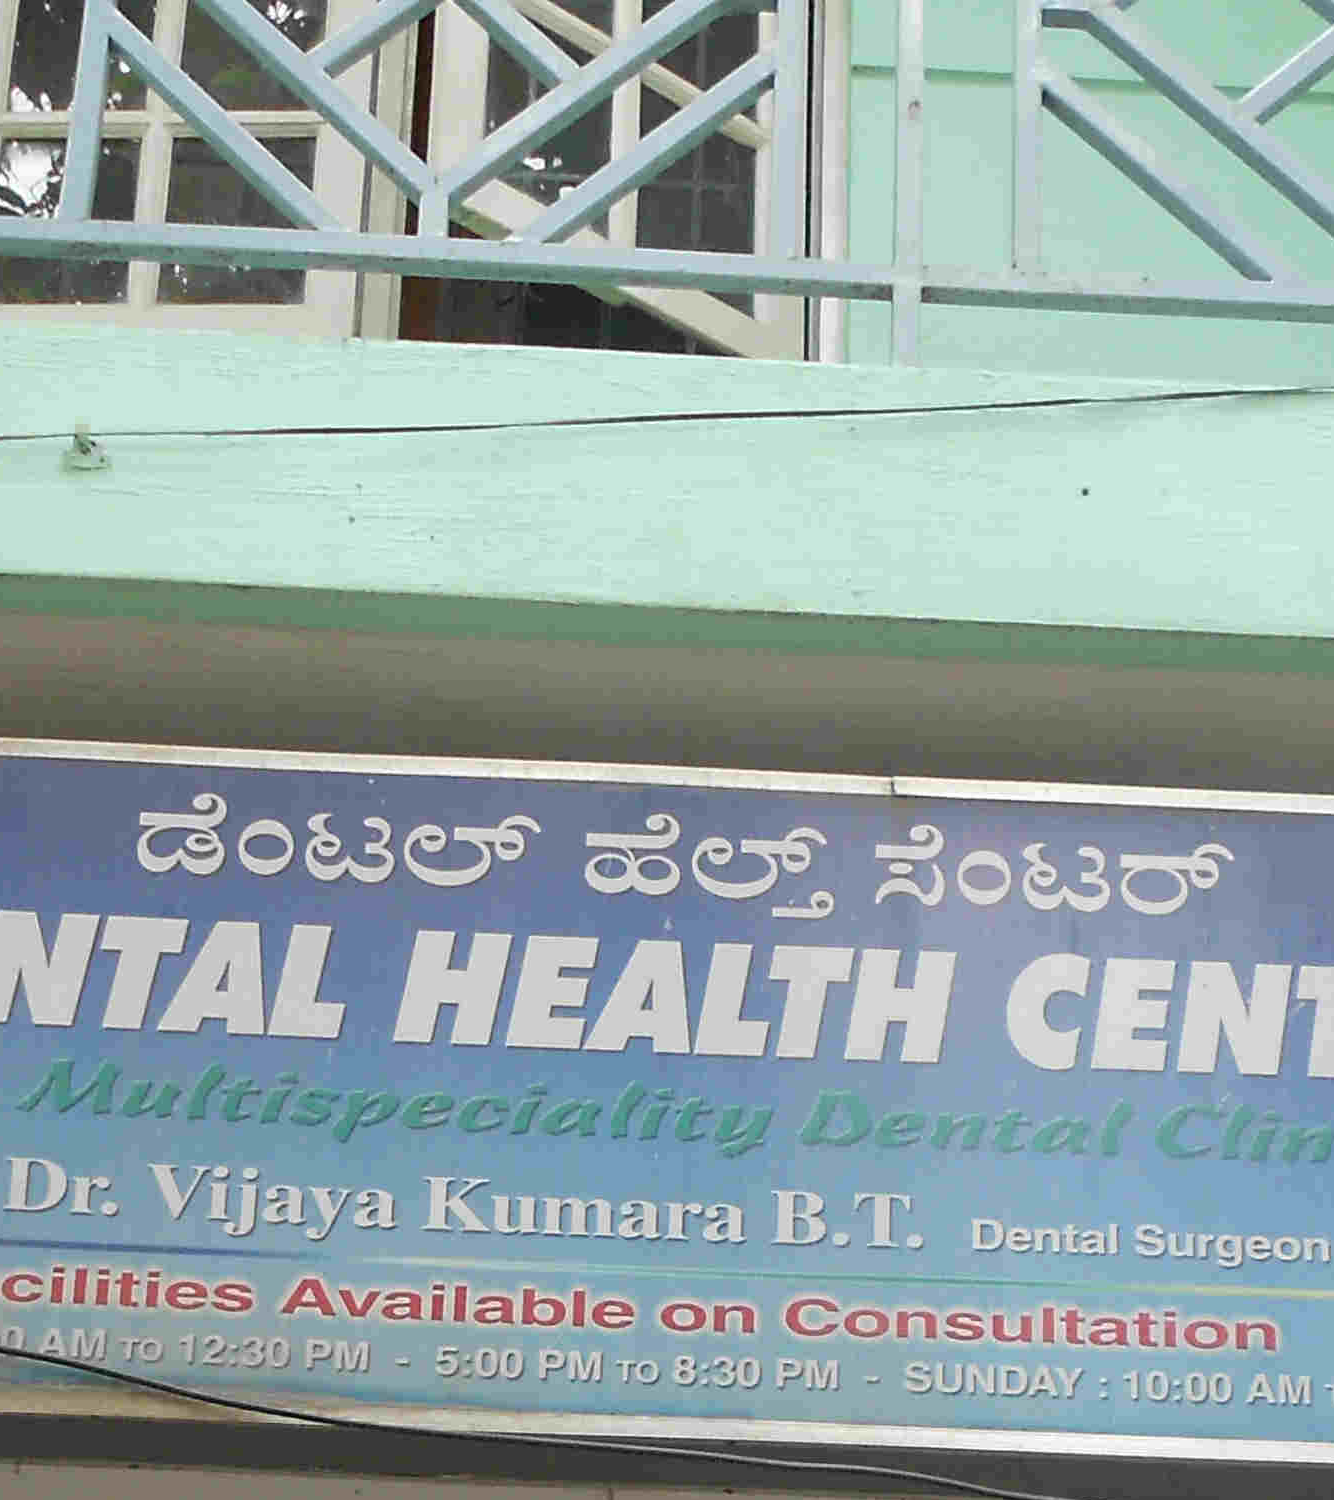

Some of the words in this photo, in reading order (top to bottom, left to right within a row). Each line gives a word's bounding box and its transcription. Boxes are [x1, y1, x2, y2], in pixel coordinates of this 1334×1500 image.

[137, 793, 542, 888] ಡೆಂಟಲ್
[583, 813, 835, 920] ಹೆಲ್ತ್
[874, 824, 1234, 915] ಸೆಂಟರ್
[392, 931, 957, 1064] HEALTH
[15, 1057, 774, 1156] Multispeciality
[797, 1088, 1135, 1157] Dental
[3, 1157, 119, 1218] Dr.
[148, 1161, 397, 1242] Vijaya
[422, 1175, 745, 1246] Kumara
[771, 1189, 925, 1250] B.T.
[971, 1218, 1119, 1258] Dental
[1133, 1222, 1332, 1267] Surgeon
[281, 1277, 636, 1330] Available
[659, 1299, 756, 1335] on
[784, 1297, 1280, 1351] Consultation
[38, 1327, 109, 1361] AM
[119, 1336, 164, 1362] TO
[178, 1334, 291, 1370] 12:30
[304, 1340, 371, 1374] PM
[434, 1346, 524, 1380] 5:00
[537, 1349, 604, 1383] PM
[616, 1359, 659, 1384] TO
[670, 1355, 762, 1389] 8:30
[774, 1358, 840, 1391] PM
[904, 1361, 1085, 1399] SUNDAY
[1122, 1372, 1233, 1405] 10:00
[1245, 1374, 1313, 1408] AM
